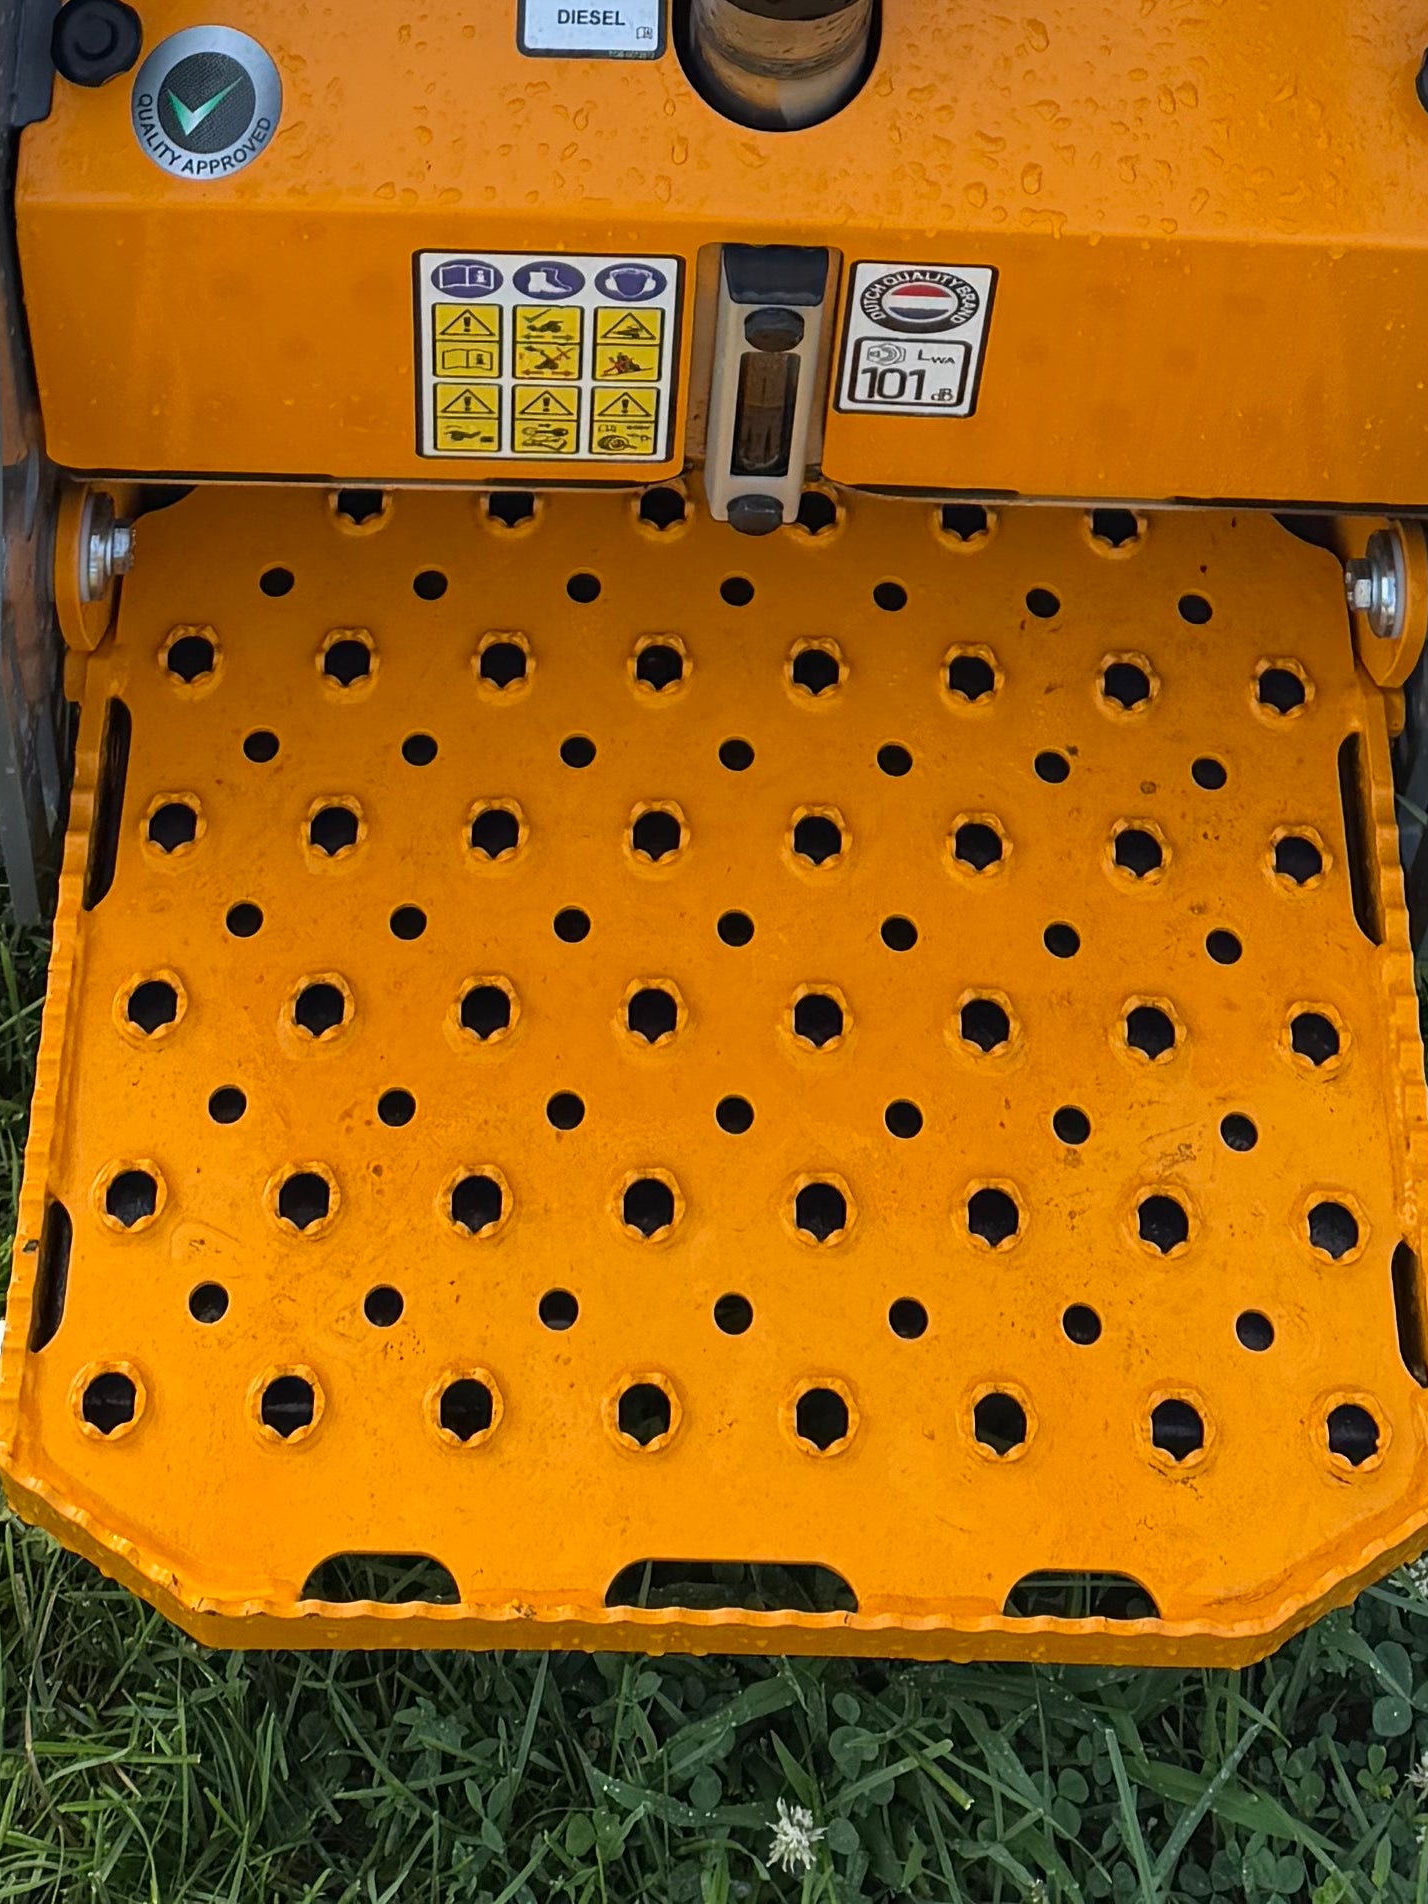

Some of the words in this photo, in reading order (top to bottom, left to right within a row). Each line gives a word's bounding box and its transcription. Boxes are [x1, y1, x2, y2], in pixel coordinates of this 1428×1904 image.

[557, 9, 626, 26] DIESEL
[137, 93, 182, 166] QUALITY
[181, 117, 271, 175] APPROVED
[864, 283, 887, 321] DUTCH
[883, 271, 963, 289] QUALITY
[950, 286, 976, 324] BRAND
[861, 366, 926, 401] 101
[931, 388, 954, 402] dB
